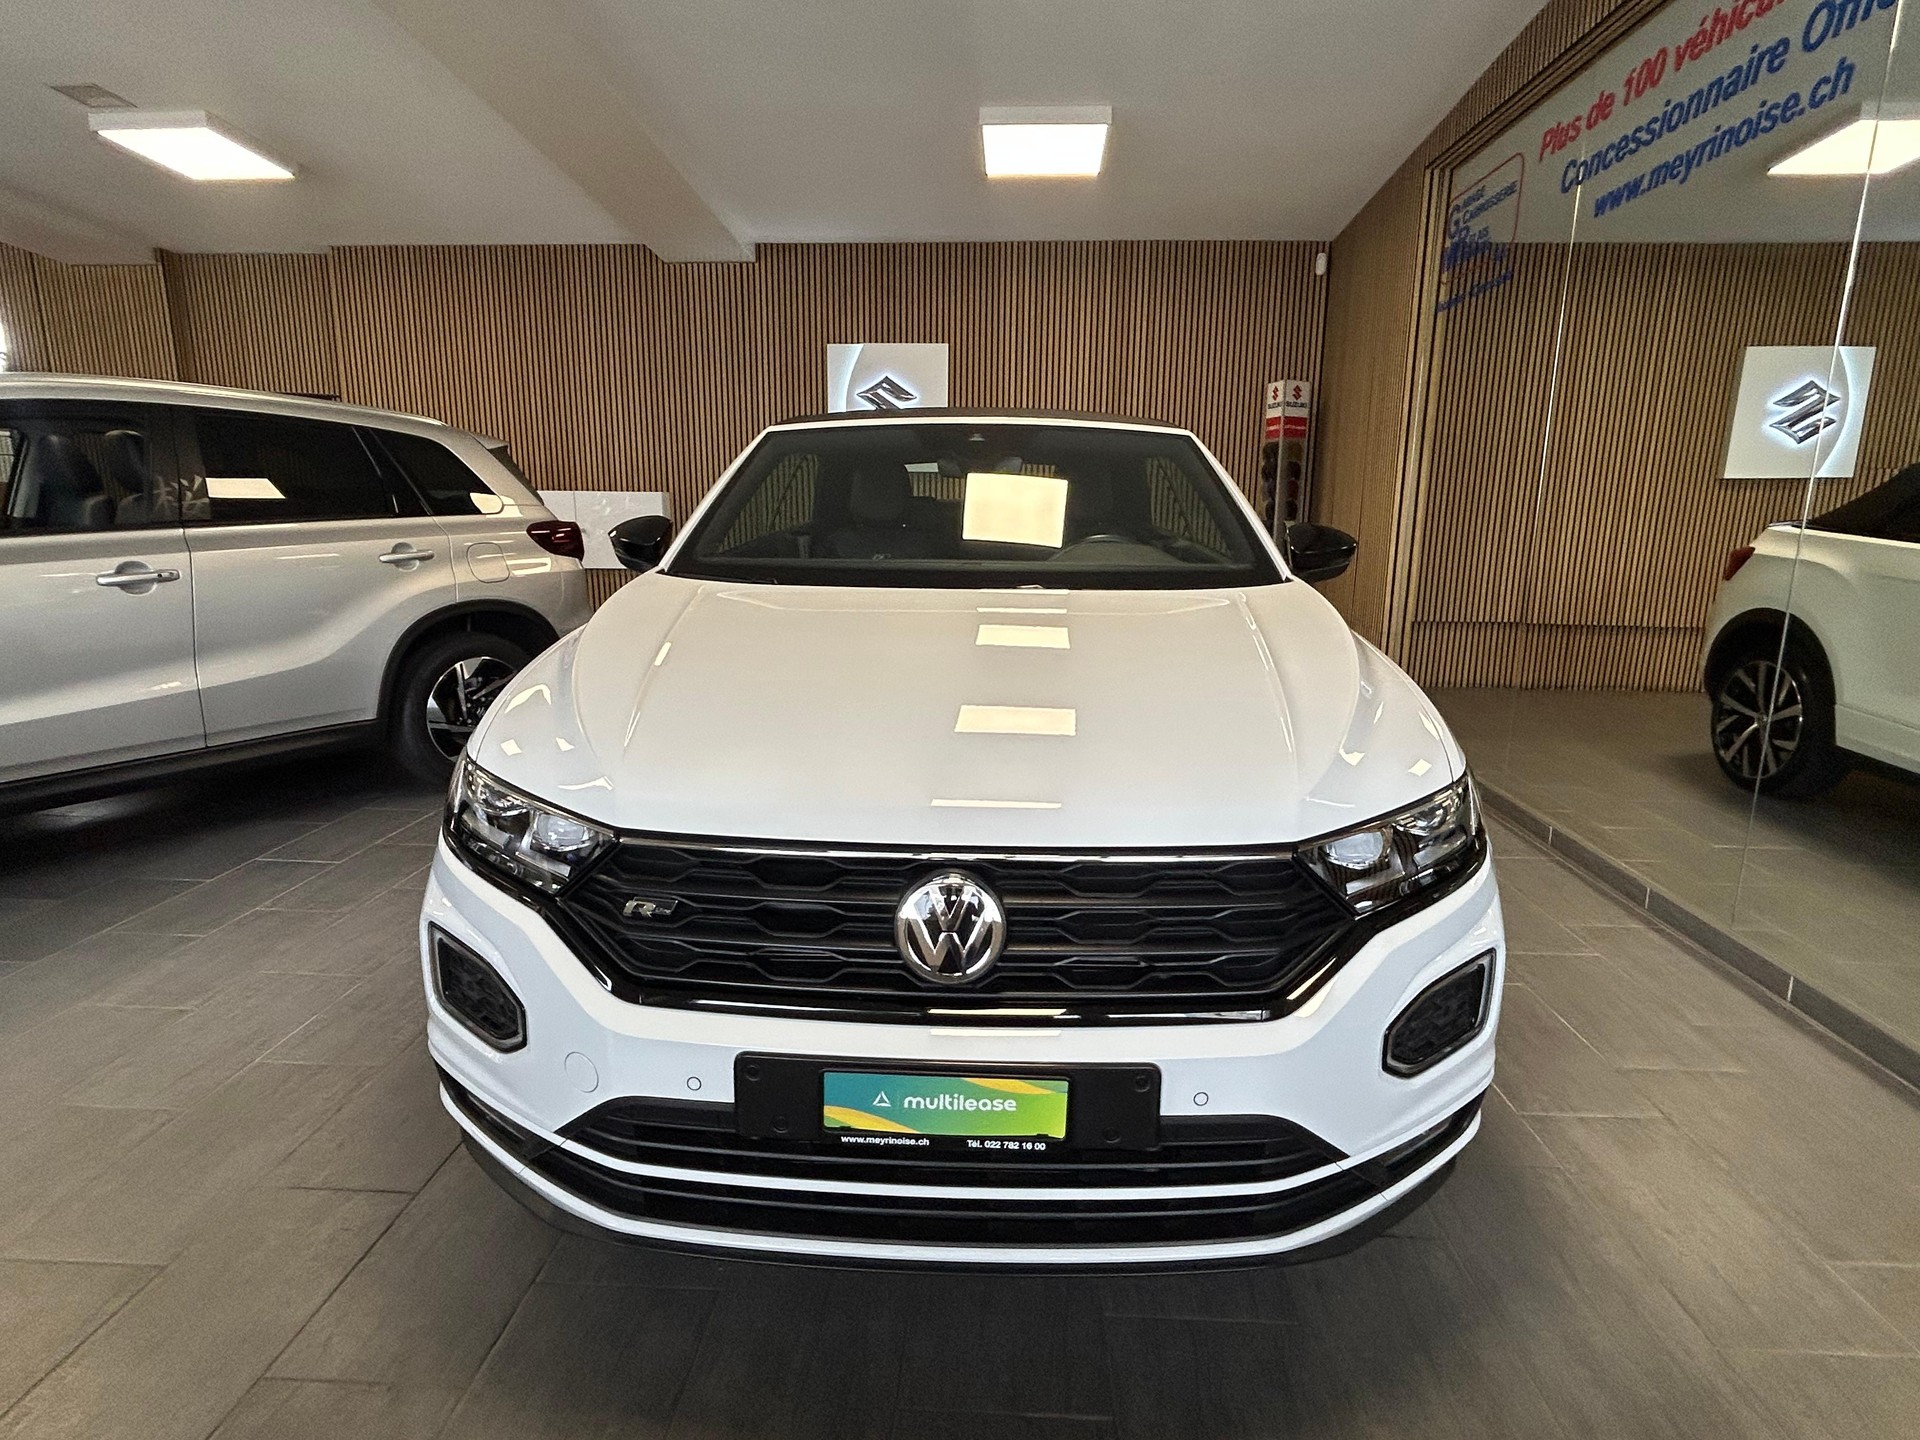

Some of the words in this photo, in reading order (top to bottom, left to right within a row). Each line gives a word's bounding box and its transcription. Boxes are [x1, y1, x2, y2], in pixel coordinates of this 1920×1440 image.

[1539, 115, 1583, 163] Plus
[1585, 90, 1616, 130] de
[1623, 46, 1668, 107] 100
[1673, 0, 1785, 72] véhicu
[1560, 36, 1791, 194] Concessionnaire
[1802, 0, 1896, 53] Off
[1593, 56, 1857, 219] www.meyrinoise.ch
[840, 1136, 930, 1146] www.meyrinoise.ch
[903, 1093, 1017, 1111] multilease
[966, 1139, 983, 1148] Tél.
[984, 1140, 1001, 1149] 022
[1003, 1141, 1020, 1150] 782
[1022, 1142, 1033, 1150] 16
[1034, 1142, 1047, 1151] 00
